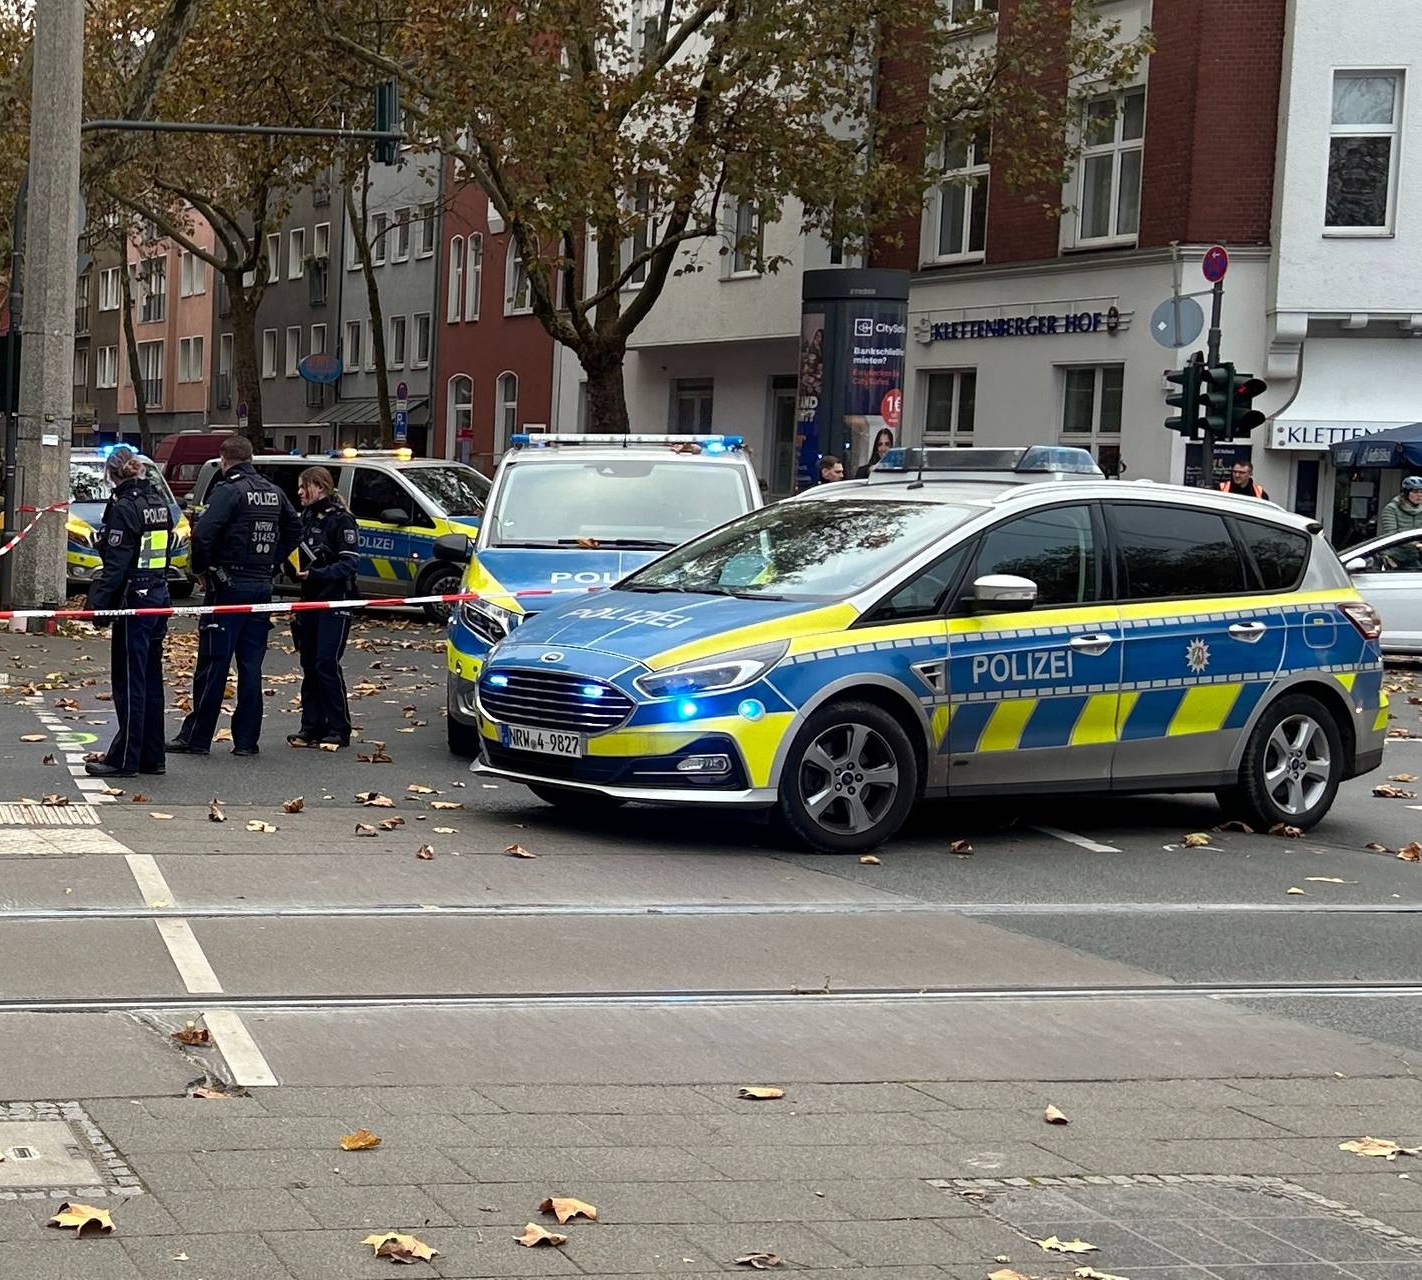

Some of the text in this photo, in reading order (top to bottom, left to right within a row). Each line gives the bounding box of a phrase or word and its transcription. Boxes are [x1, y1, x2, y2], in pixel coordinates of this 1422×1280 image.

[932, 312, 1102, 340] KLETTENBERGER HOF
[254, 521, 274, 532] NRW
[557, 607, 693, 629] POLIZEI
[972, 650, 1074, 684] POLIZEI
[509, 727, 579, 755] NRW 4-9827
